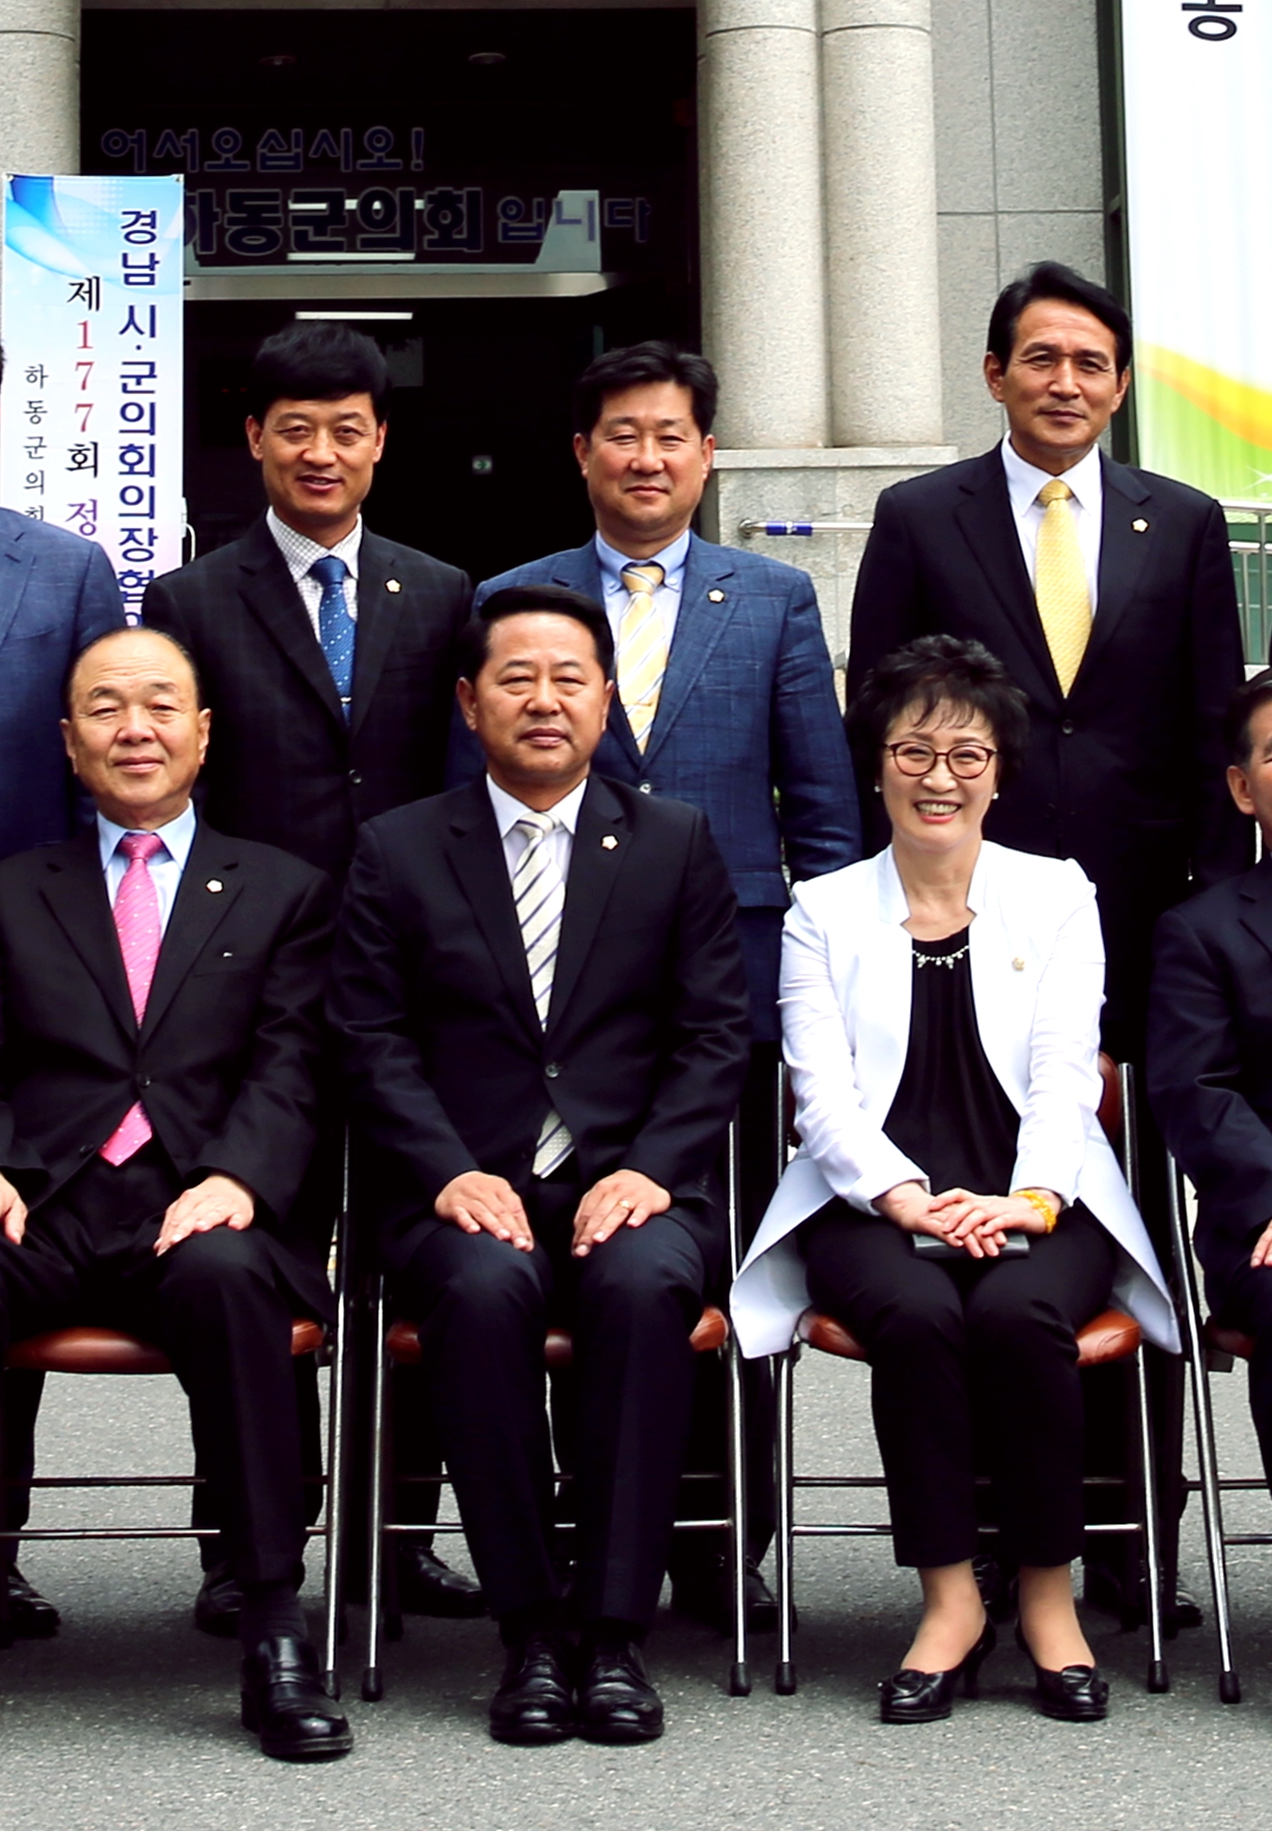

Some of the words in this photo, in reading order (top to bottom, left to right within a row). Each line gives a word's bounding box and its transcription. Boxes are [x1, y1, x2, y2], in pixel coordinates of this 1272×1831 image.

[100, 126, 426, 174] 어서오십시오!
[120, 209, 160, 287] 경남
[65, 275, 101, 479] 제177회
